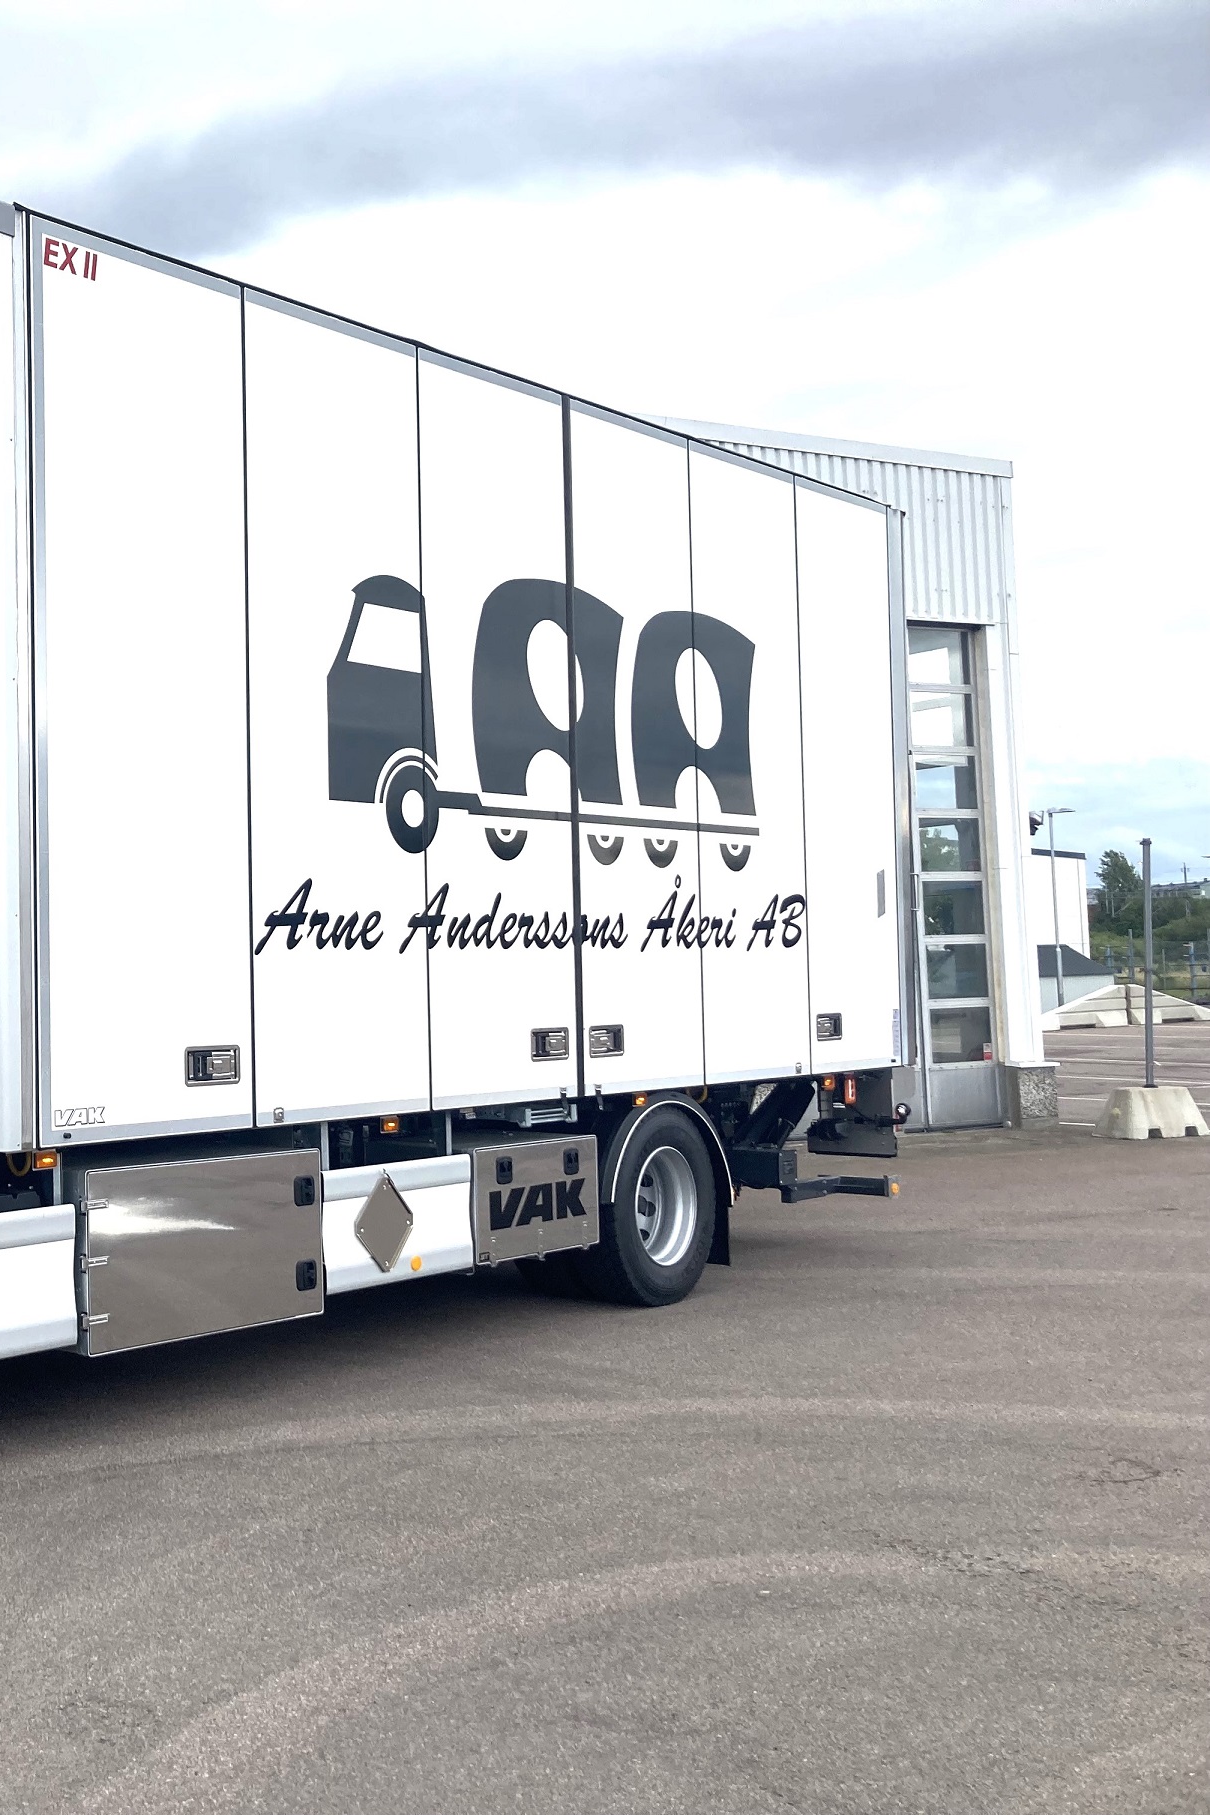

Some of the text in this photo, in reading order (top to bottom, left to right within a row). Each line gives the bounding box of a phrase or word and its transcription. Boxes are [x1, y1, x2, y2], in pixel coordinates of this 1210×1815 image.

[43, 237, 99, 282] EX II
[254, 874, 806, 955] Arne Anderssons Åkeri AB
[53, 1106, 106, 1128] VAK
[488, 1177, 588, 1232] VAK
